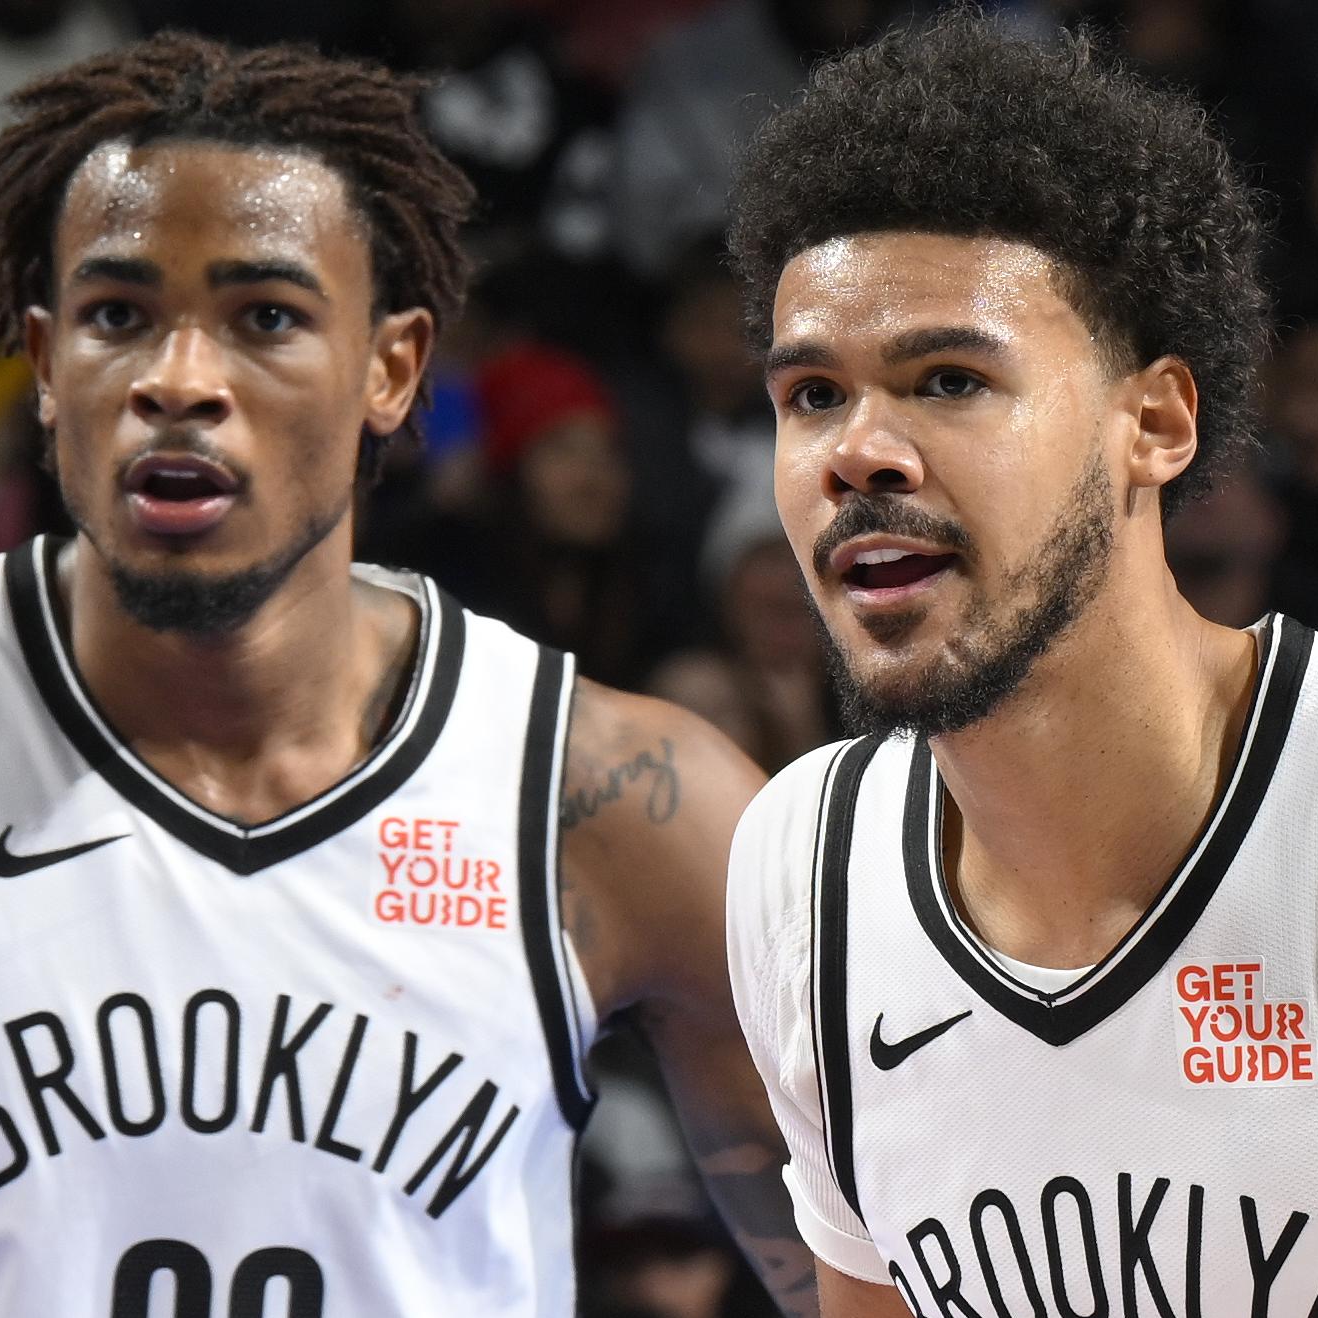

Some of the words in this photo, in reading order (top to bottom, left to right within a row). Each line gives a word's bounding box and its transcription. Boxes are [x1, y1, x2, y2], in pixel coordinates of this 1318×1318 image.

[378, 817, 460, 851] GET
[379, 853, 501, 892] YOUR
[375, 889, 507, 929] GUIDE
[1176, 963, 1261, 1003] GET
[1179, 1002, 1306, 1043] YOUR
[1183, 1043, 1314, 1084] GUIDE
